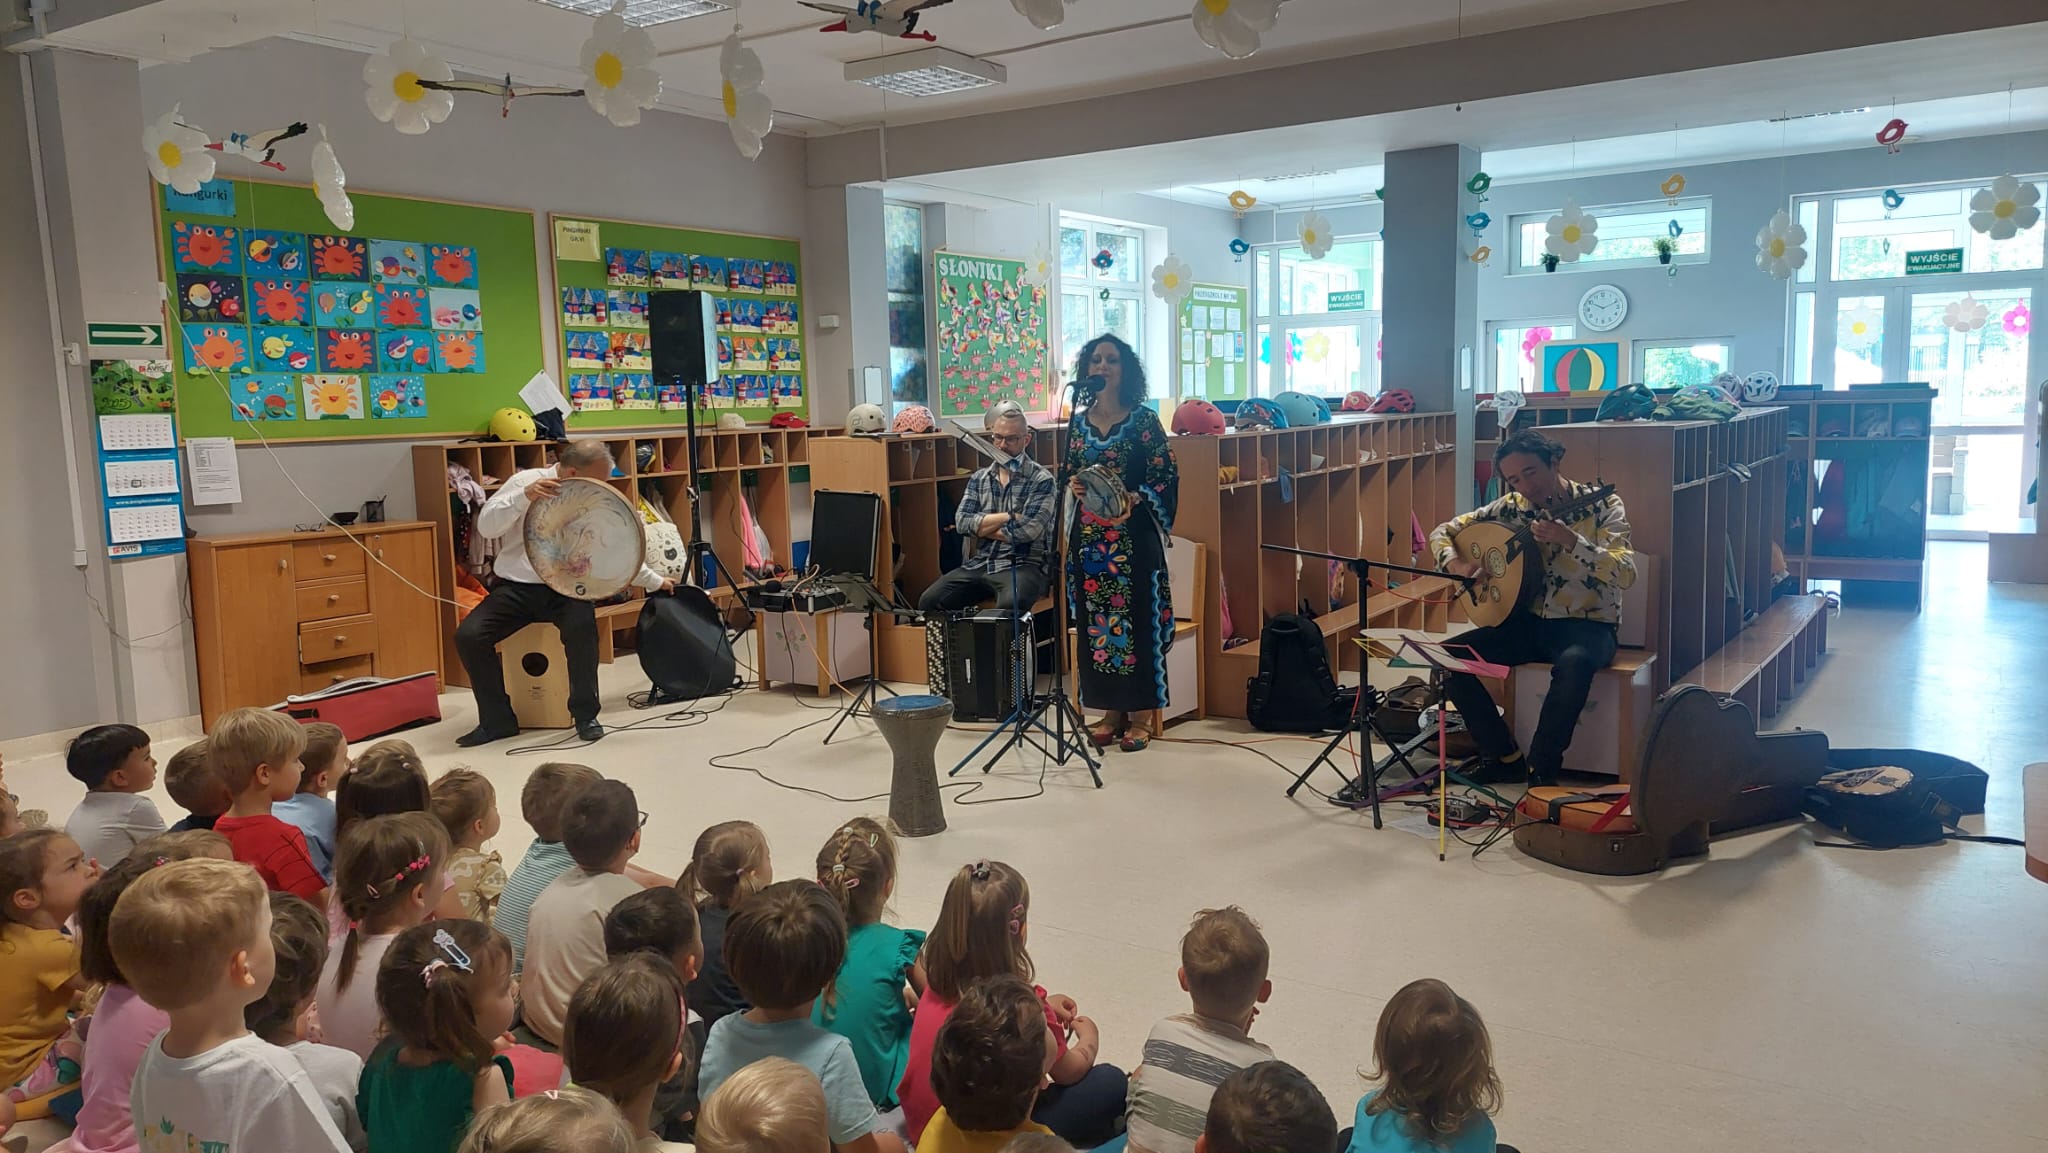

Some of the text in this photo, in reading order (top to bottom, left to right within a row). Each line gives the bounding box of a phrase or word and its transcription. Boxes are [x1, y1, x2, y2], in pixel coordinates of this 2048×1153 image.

[1910, 252, 1959, 264] WYJŚCIE
[938, 258, 1003, 282] SŁONIKI
[1907, 262, 1961, 272] EWAKUACYJNE
[1330, 292, 1362, 302] WYJŚCIE
